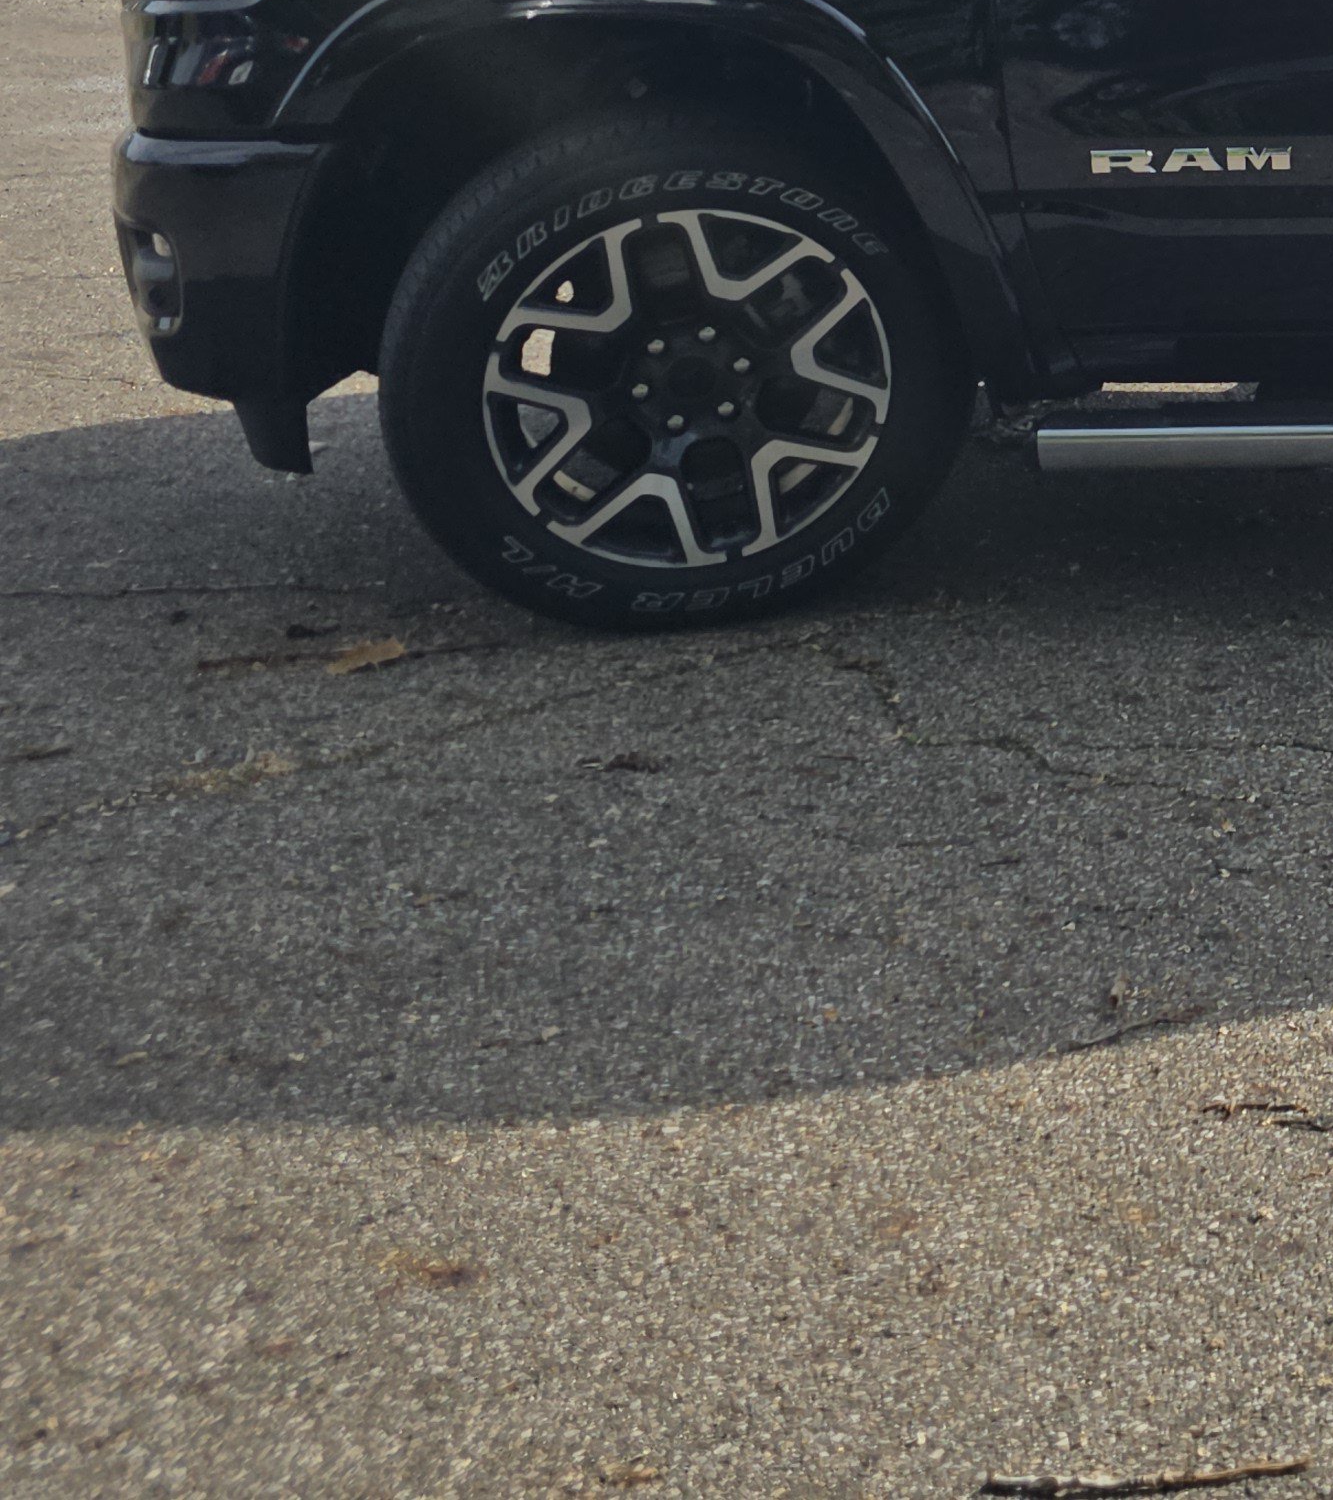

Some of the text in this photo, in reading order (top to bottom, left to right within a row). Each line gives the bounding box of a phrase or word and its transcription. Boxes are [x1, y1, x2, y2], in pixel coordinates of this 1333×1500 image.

[1090, 147, 1292, 174] RAM
[476, 169, 890, 302] BRIDGESTONE
[630, 486, 892, 612] DUELER
